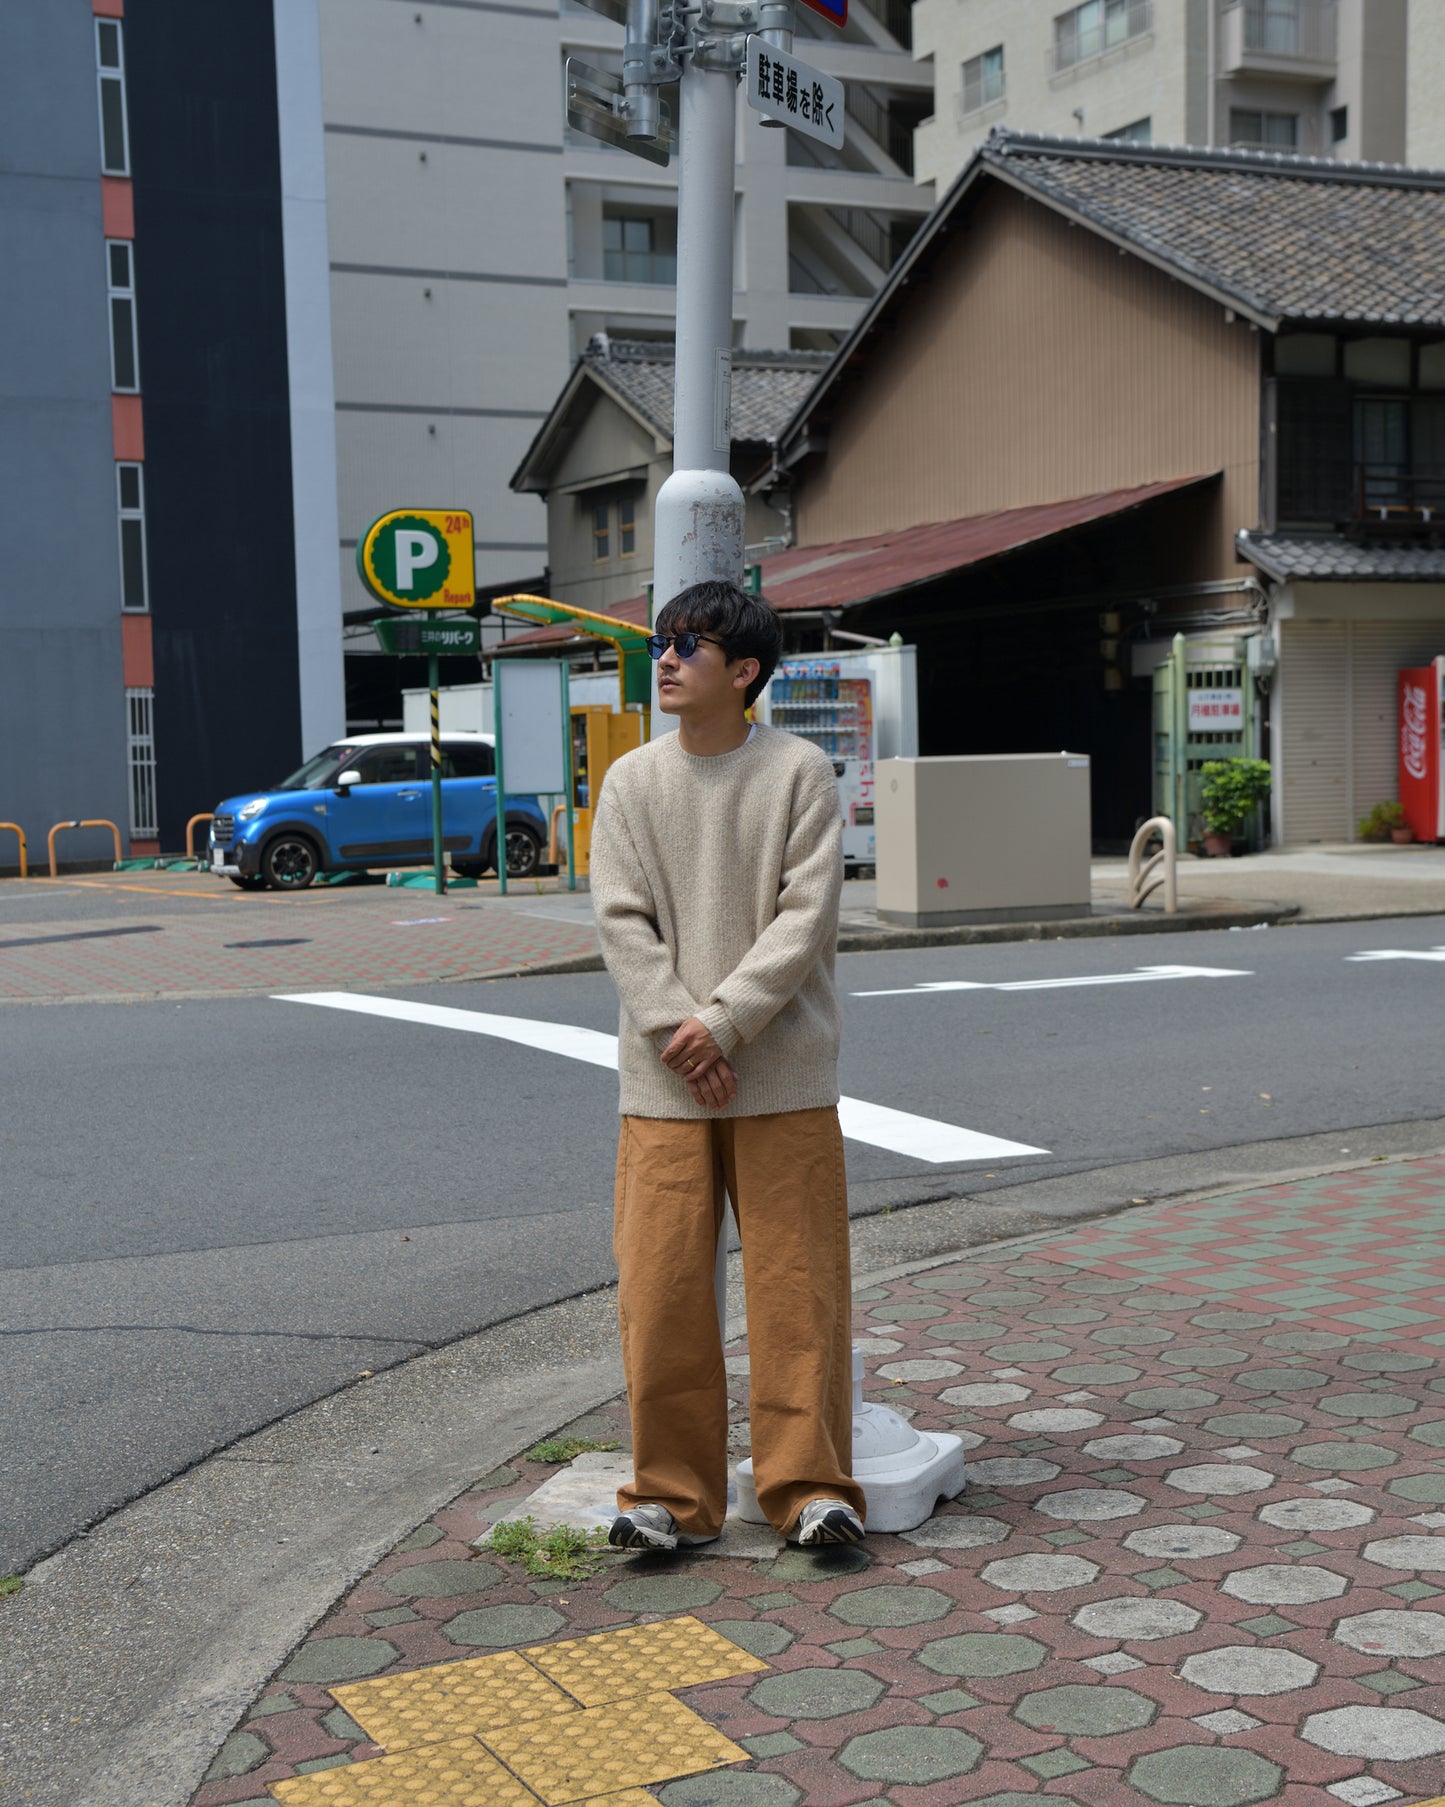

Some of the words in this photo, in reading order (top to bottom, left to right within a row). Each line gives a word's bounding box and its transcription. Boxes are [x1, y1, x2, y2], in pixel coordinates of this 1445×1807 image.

[758, 53, 835, 133] 駐車場を除く
[445, 515, 470, 534] 24h
[394, 529, 439, 591] P
